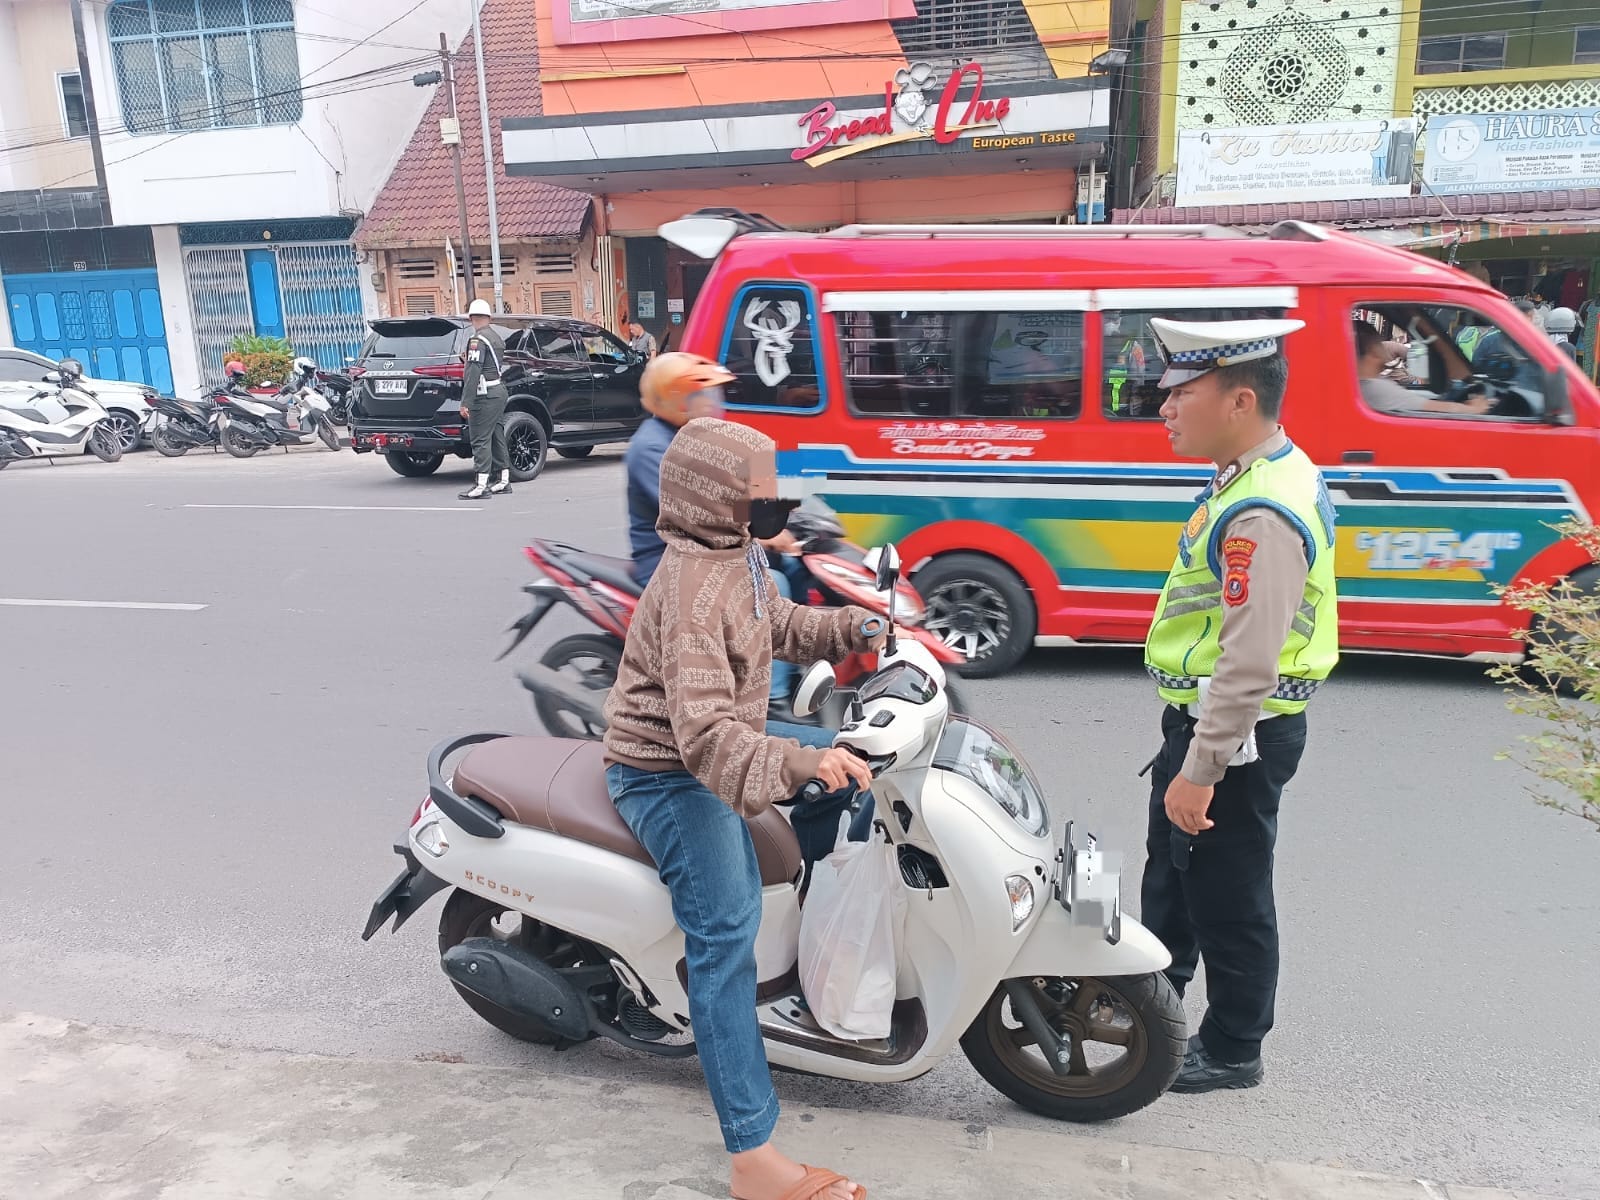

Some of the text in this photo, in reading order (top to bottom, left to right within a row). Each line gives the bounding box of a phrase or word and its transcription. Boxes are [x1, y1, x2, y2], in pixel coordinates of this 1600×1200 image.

[791, 62, 1010, 160] Bread One
[1484, 112, 1587, 142] HAURA
[972, 131, 1076, 149] European Taste
[1272, 129, 1383, 157] Fashion
[1496, 139, 1583, 152] Kids Fashion
[1474, 182, 1520, 191] MERDEKA
[467, 350, 480, 361] PM
[464, 869, 535, 903] SCOOPY
